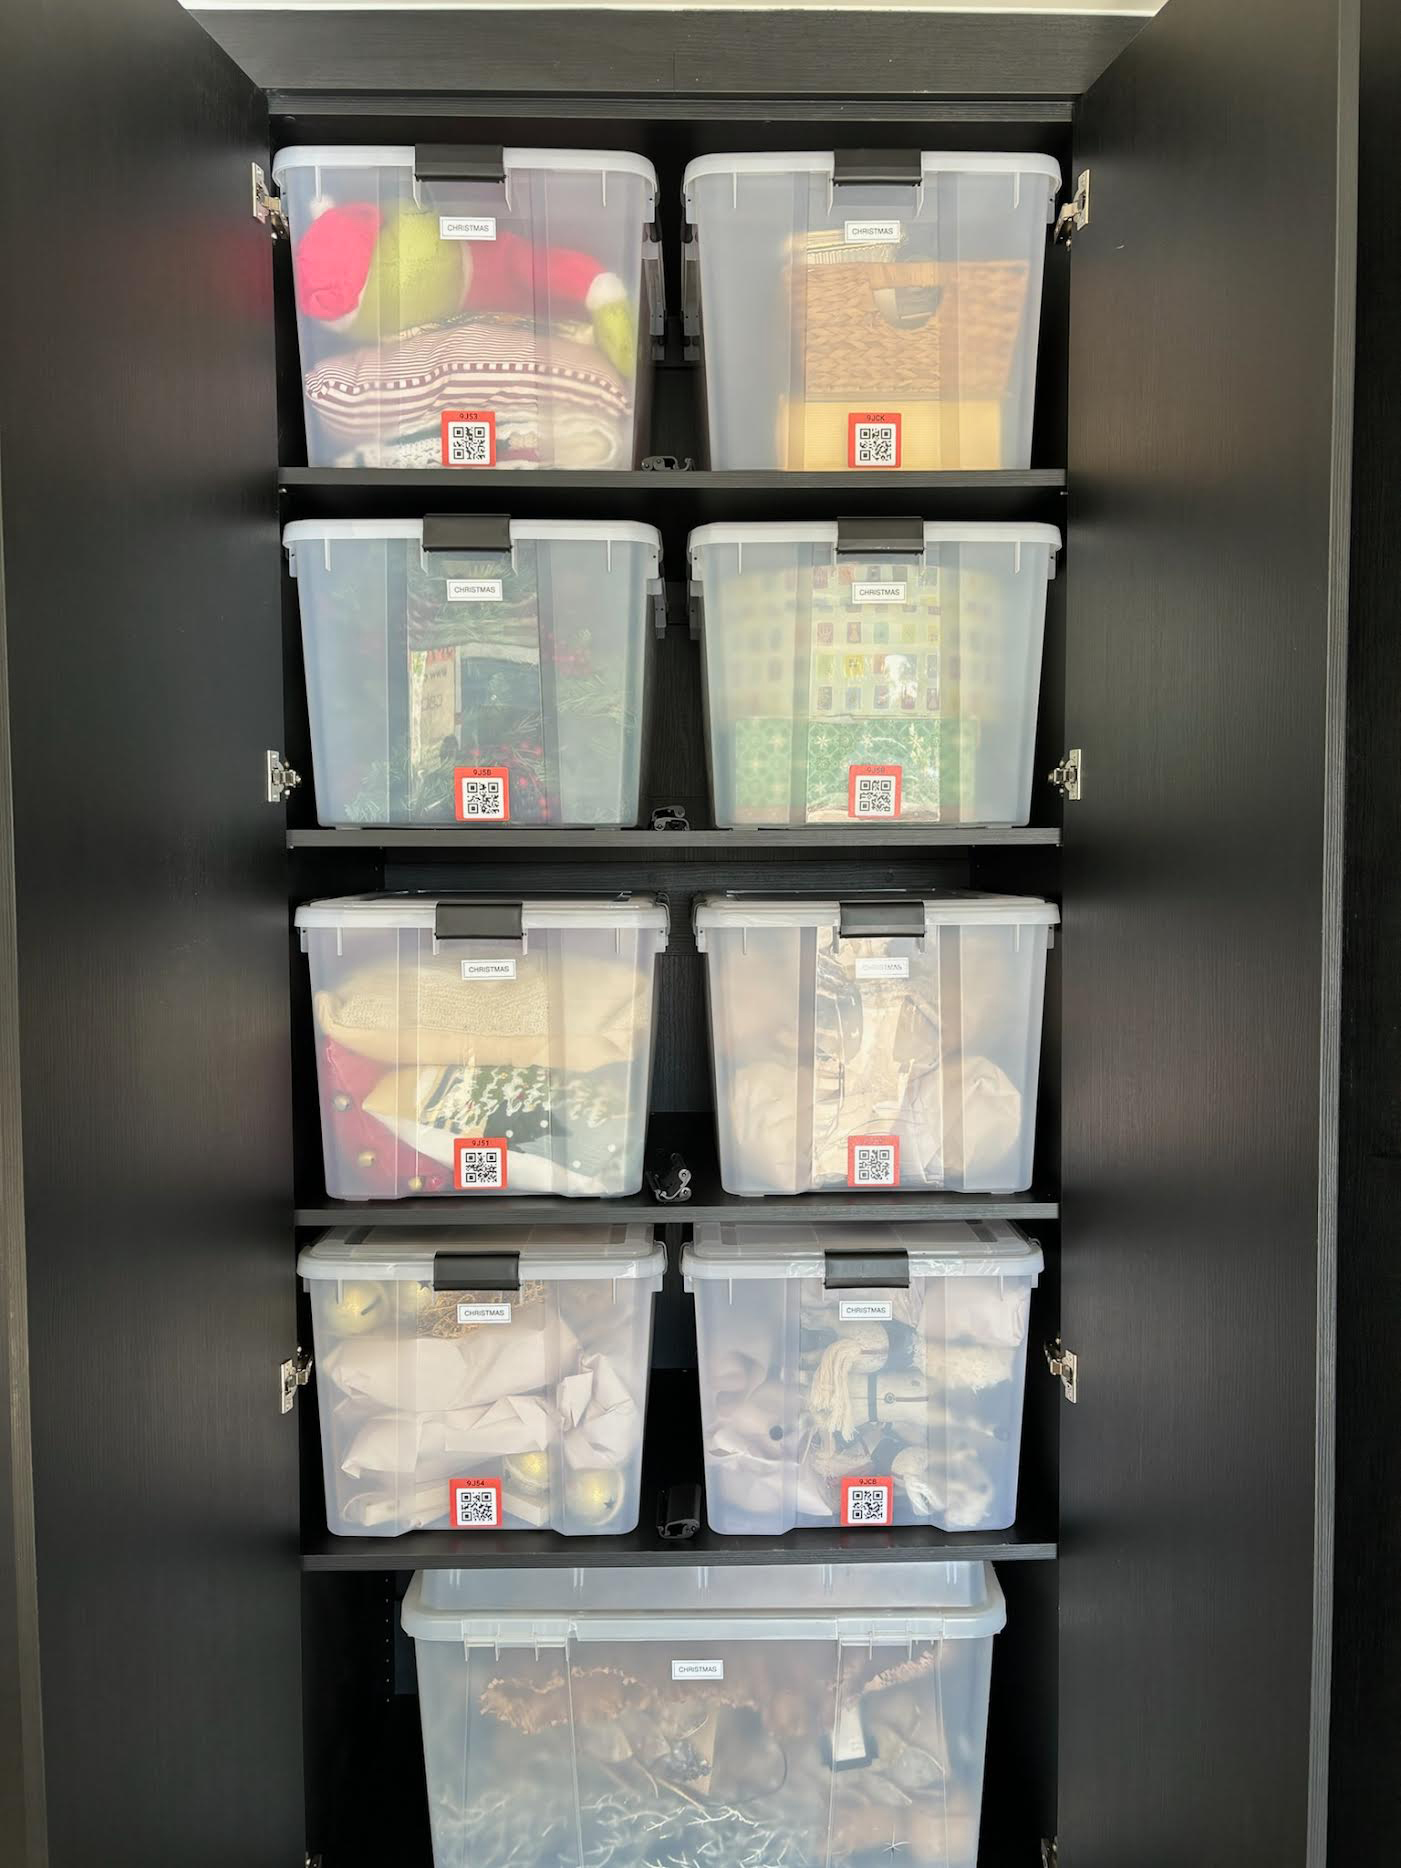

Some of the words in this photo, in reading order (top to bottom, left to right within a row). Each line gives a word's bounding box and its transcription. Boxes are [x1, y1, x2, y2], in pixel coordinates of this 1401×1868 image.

[447, 224, 489, 232] CHRISTMAS
[852, 228, 894, 236] CHRISTMAS
[454, 586, 496, 594] CHRISTMAS
[859, 588, 900, 596] CHRISTMAS
[468, 965, 510, 973] CHRISTMAS
[862, 963, 903, 971] CTMAS
[464, 1309, 505, 1317] CHRISTMAS
[846, 1306, 886, 1314] CHRISTMAS
[678, 1665, 718, 1673] CHRISTMAS
